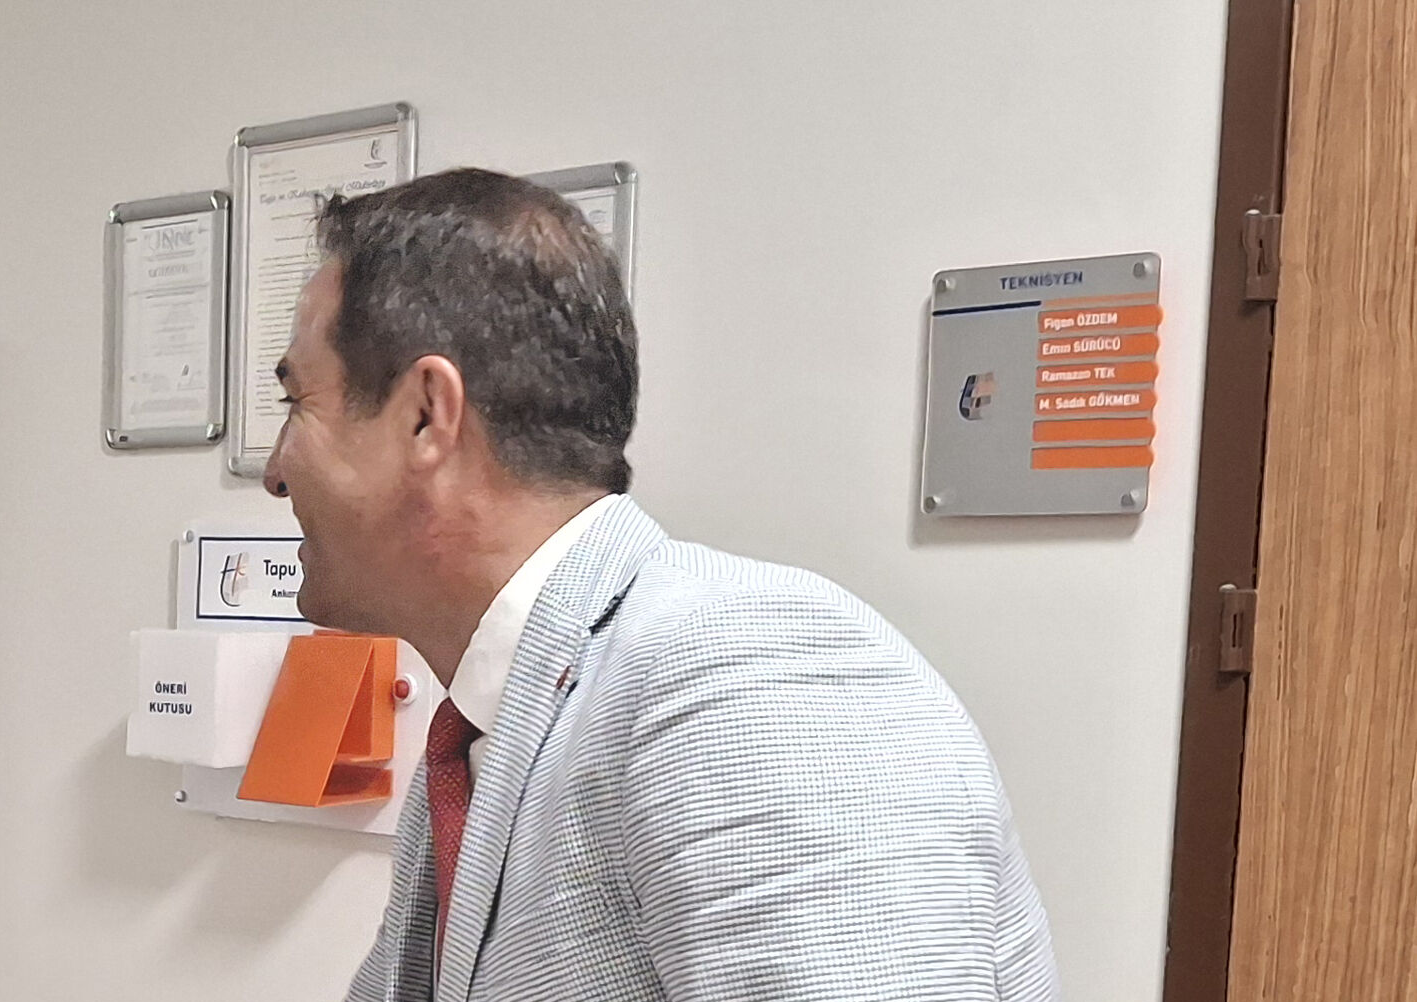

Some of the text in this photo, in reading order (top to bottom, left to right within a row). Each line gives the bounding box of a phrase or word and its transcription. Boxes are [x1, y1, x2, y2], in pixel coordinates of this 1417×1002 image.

[1094, 367, 1116, 379] TEK
[263, 559, 296, 580] Tapu
[155, 680, 187, 695] ÖNERİ
[149, 702, 192, 715] KUTUSU
